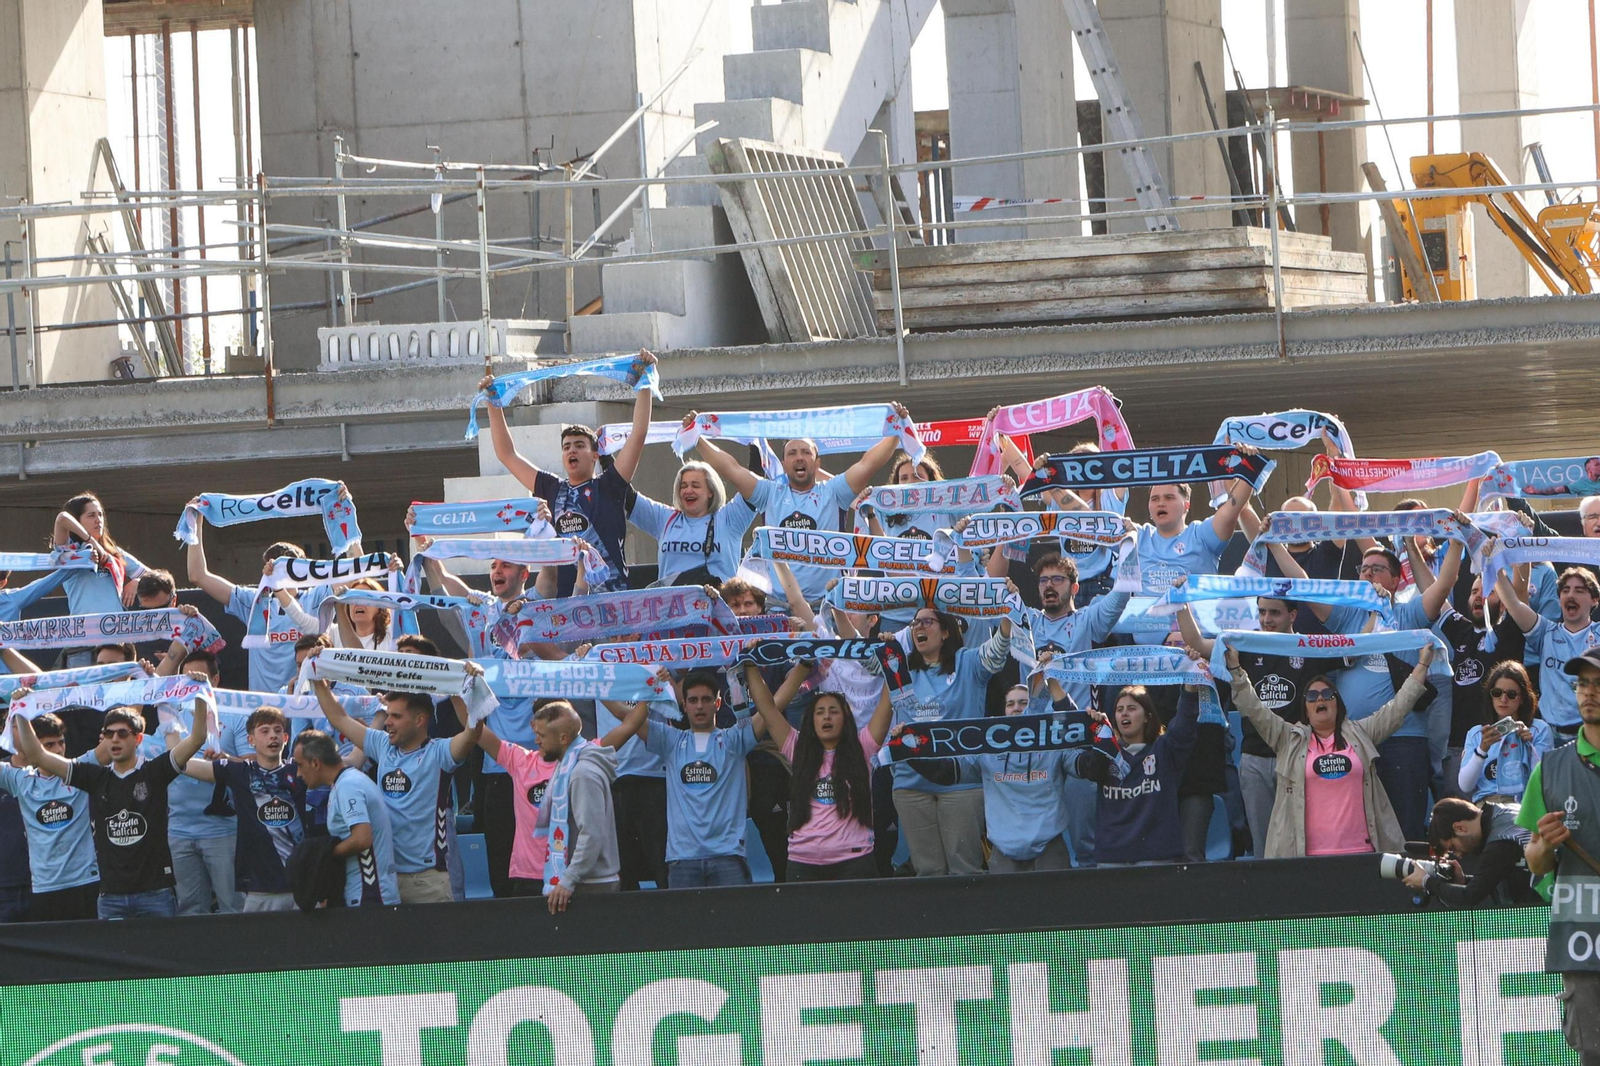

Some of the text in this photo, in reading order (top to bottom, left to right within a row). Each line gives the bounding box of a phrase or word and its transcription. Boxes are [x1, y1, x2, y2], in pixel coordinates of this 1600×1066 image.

[1007, 391, 1094, 429] CELTA
[1062, 453, 1208, 482] RC CELTA
[1413, 468, 1437, 480] SEMI
[1521, 463, 1584, 484] IAGO
[876, 482, 992, 508] CELTA
[432, 511, 477, 526] CELTA
[560, 517, 582, 526] Estrella
[785, 518, 811, 528] Estrella
[1335, 513, 1435, 530] CELTA
[561, 524, 583, 533] Galicia
[961, 516, 1040, 539] EURO
[661, 541, 721, 553] CITRON
[768, 528, 851, 556] EURO
[772, 551, 847, 566] SOMOS FILLOS
[843, 577, 1022, 612] EURO CELTA
[571, 594, 689, 630] CELTA
[0, 611, 173, 641] SEMPRE CELTA
[1297, 638, 1307, 648] A
[600, 643, 675, 663] CELTA
[680, 641, 712, 661] DE
[333, 652, 451, 671] PEÑA MURADANA CELTISTA
[357, 666, 422, 680] Sempre Celta
[602, 664, 617, 679] E
[505, 679, 614, 697] AFOUTEZA
[1260, 682, 1289, 693] Estrella
[1259, 691, 1287, 701] Galicia
[928, 719, 1086, 753] RCCelta
[1318, 756, 1346, 767] Estrella
[1319, 763, 1345, 773] Galicia
[685, 766, 712, 776] Estrella
[685, 773, 711, 783] Galicia
[1102, 779, 1162, 800] CITROËN
[40, 805, 68, 817] Estrella
[263, 804, 290, 814] Estrella
[263, 812, 289, 821] Galicia
[42, 812, 68, 823] Galicia
[339, 945, 1402, 1066] TOGETHER
